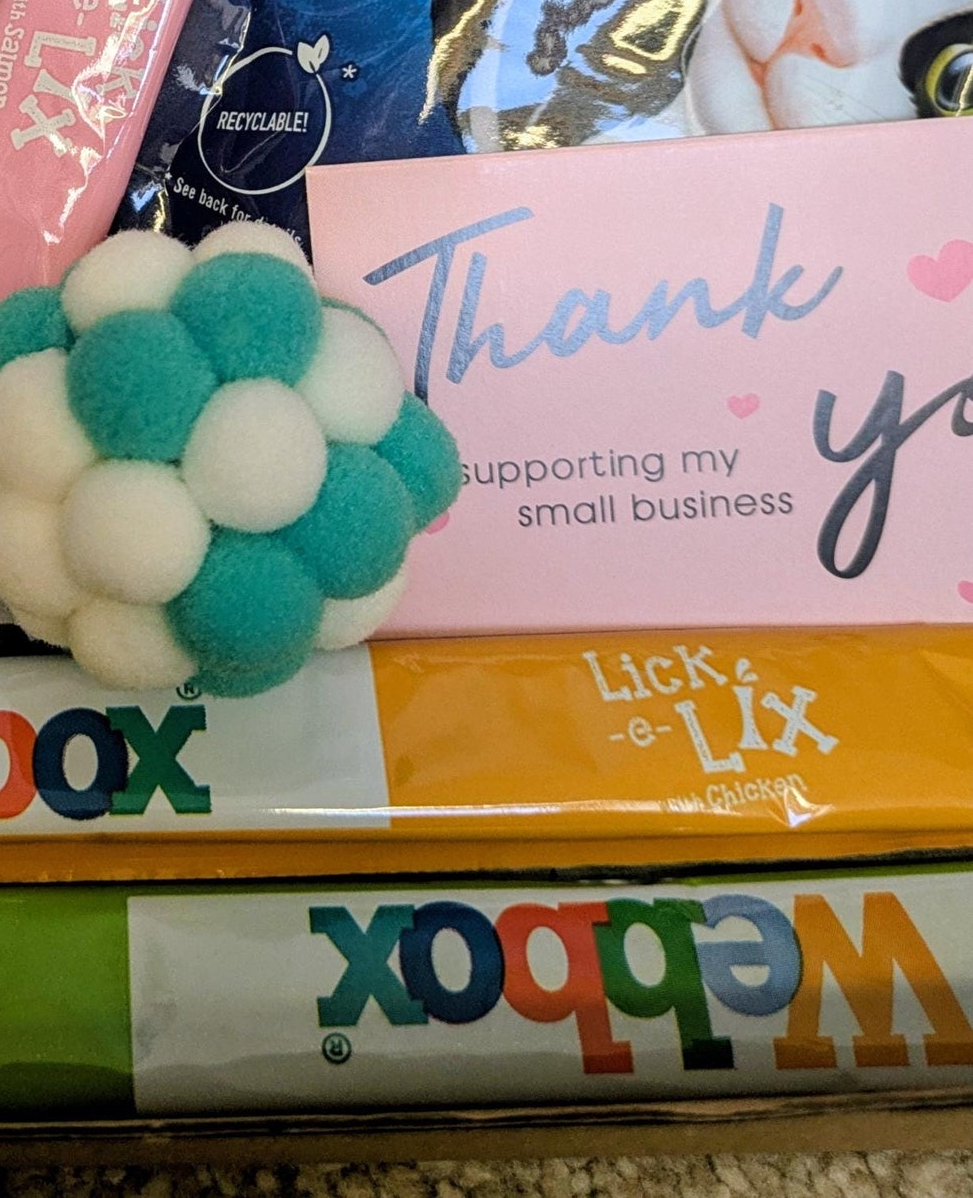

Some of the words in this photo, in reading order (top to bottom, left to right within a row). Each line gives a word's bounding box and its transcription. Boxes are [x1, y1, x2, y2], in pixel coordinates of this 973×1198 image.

[216, 111, 309, 133] RECYCLABLE!
[173, 177, 195, 199] See
[199, 189, 228, 216] back
[231, 204, 252, 222] for
[362, 202, 843, 405] Thank
[681, 448, 739, 477] my
[518, 494, 615, 527] small
[632, 490, 794, 523] business
[706, 773, 808, 810] Chicken
[309, 891, 973, 1075] Webbox
